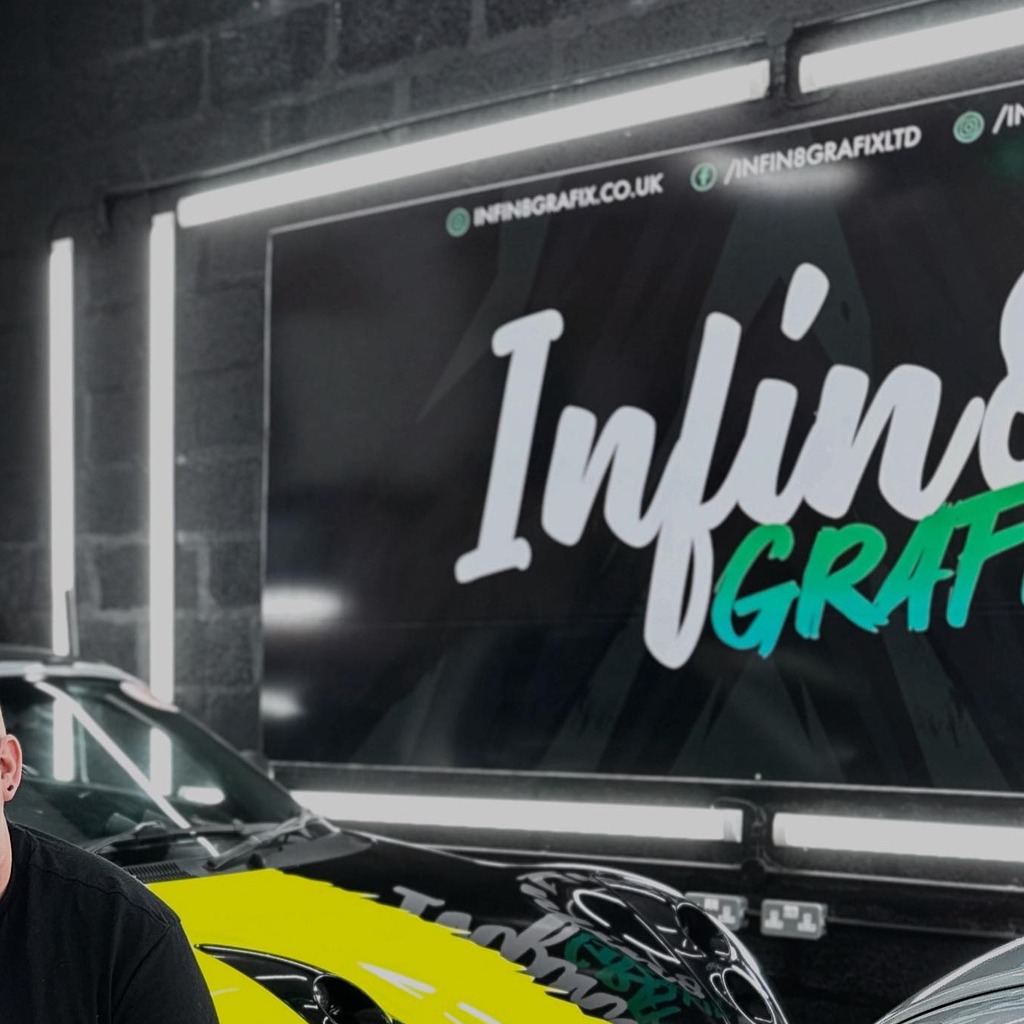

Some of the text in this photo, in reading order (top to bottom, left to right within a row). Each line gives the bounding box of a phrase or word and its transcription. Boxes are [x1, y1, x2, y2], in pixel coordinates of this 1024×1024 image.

[724, 125, 922, 186] /INFIN8GRAFIXLTD
[473, 172, 665, 227] INFIN8GRAFIX.CO.UK
[711, 481, 1024, 658] GRAF
